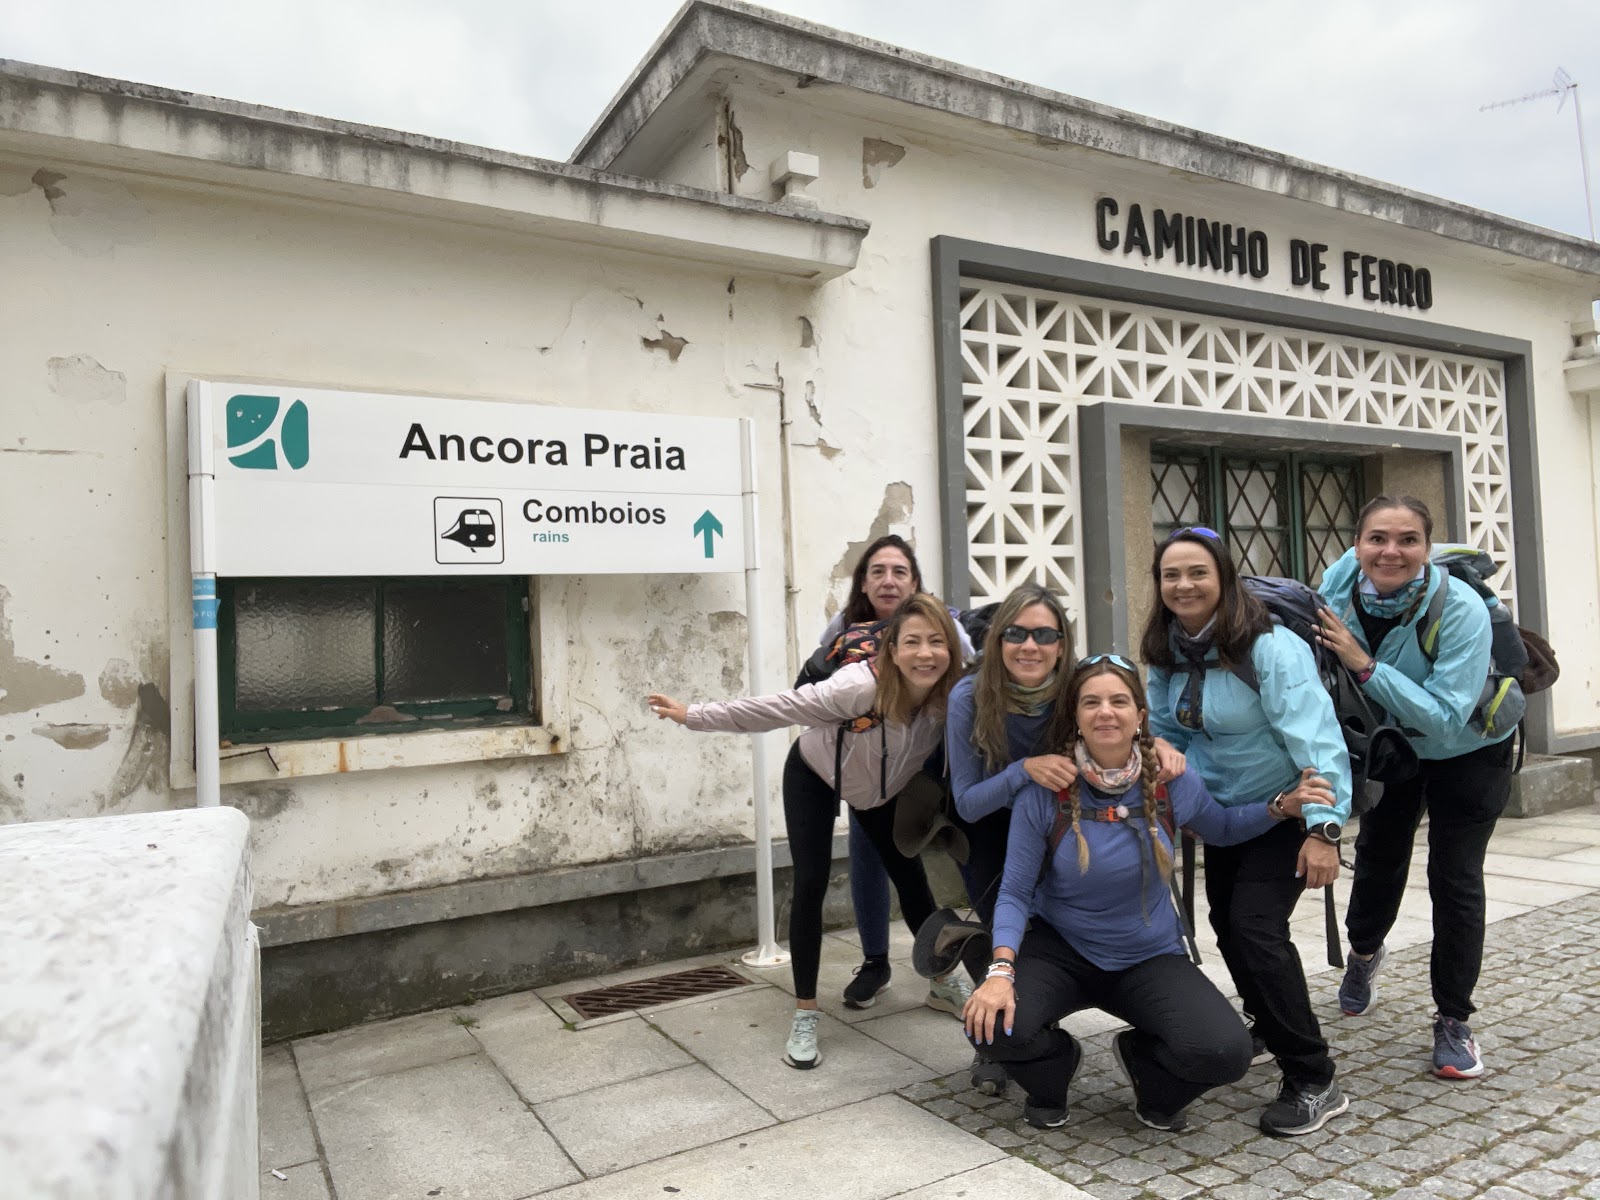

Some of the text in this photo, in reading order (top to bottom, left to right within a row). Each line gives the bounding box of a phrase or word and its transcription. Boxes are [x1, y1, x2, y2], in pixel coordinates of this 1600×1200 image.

[1096, 197, 1433, 310] CAMINHO DE FERRO
[398, 422, 687, 471] Ancora Praia
[522, 498, 667, 525] Comboios
[532, 530, 570, 543] rains
